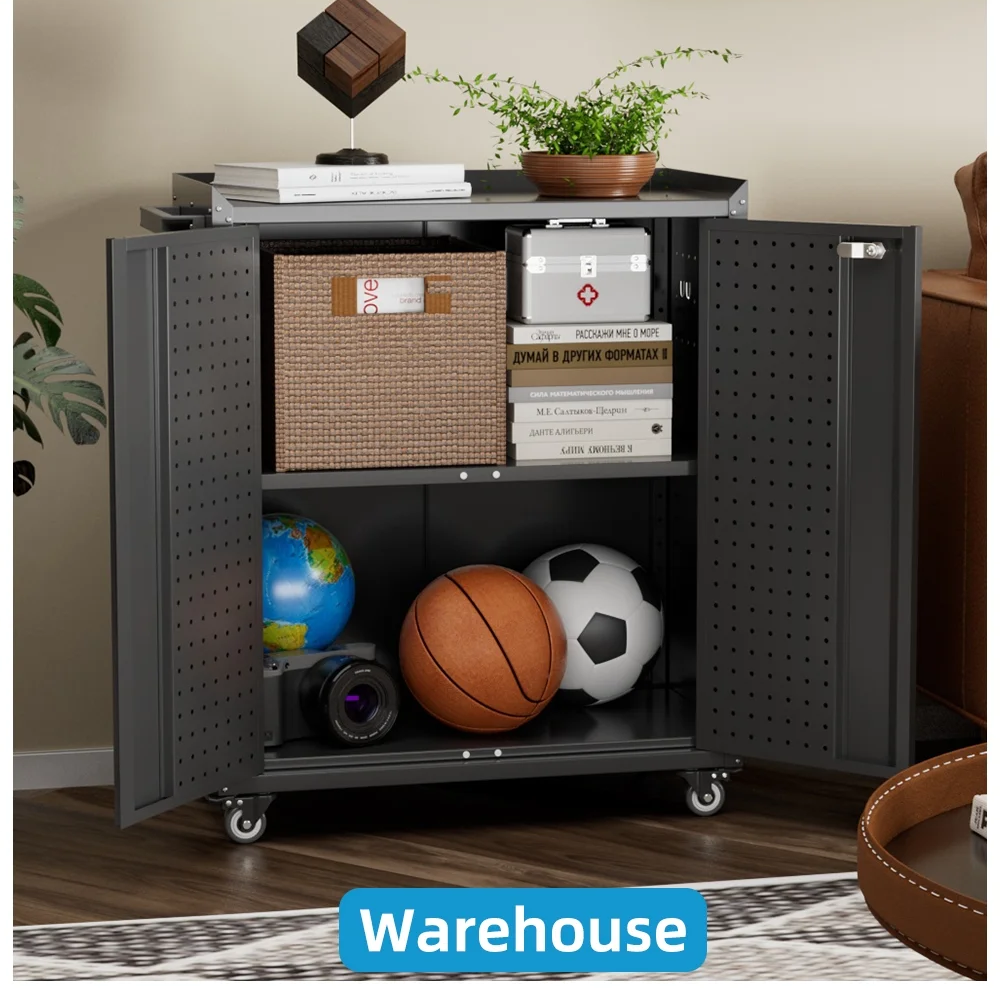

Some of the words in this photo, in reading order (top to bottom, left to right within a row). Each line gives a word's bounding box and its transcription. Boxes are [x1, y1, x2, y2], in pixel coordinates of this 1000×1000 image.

[576, 329, 614, 339] РАССКАЖИ
[616, 329, 631, 339] МНЕ
[634, 328, 638, 337] О
[640, 328, 659, 338] МОРЕ
[513, 348, 549, 365] ДУМАЙ
[553, 351, 559, 362] В
[562, 350, 602, 364] ДРУГИХ
[605, 348, 658, 362] ФОРМАТАХ
[550, 389, 614, 398] МАТЕМАТИЧЕСКОГО
[529, 428, 553, 437] ДАНТЕ
[555, 427, 593, 437] АЛИГЬЕРИ
